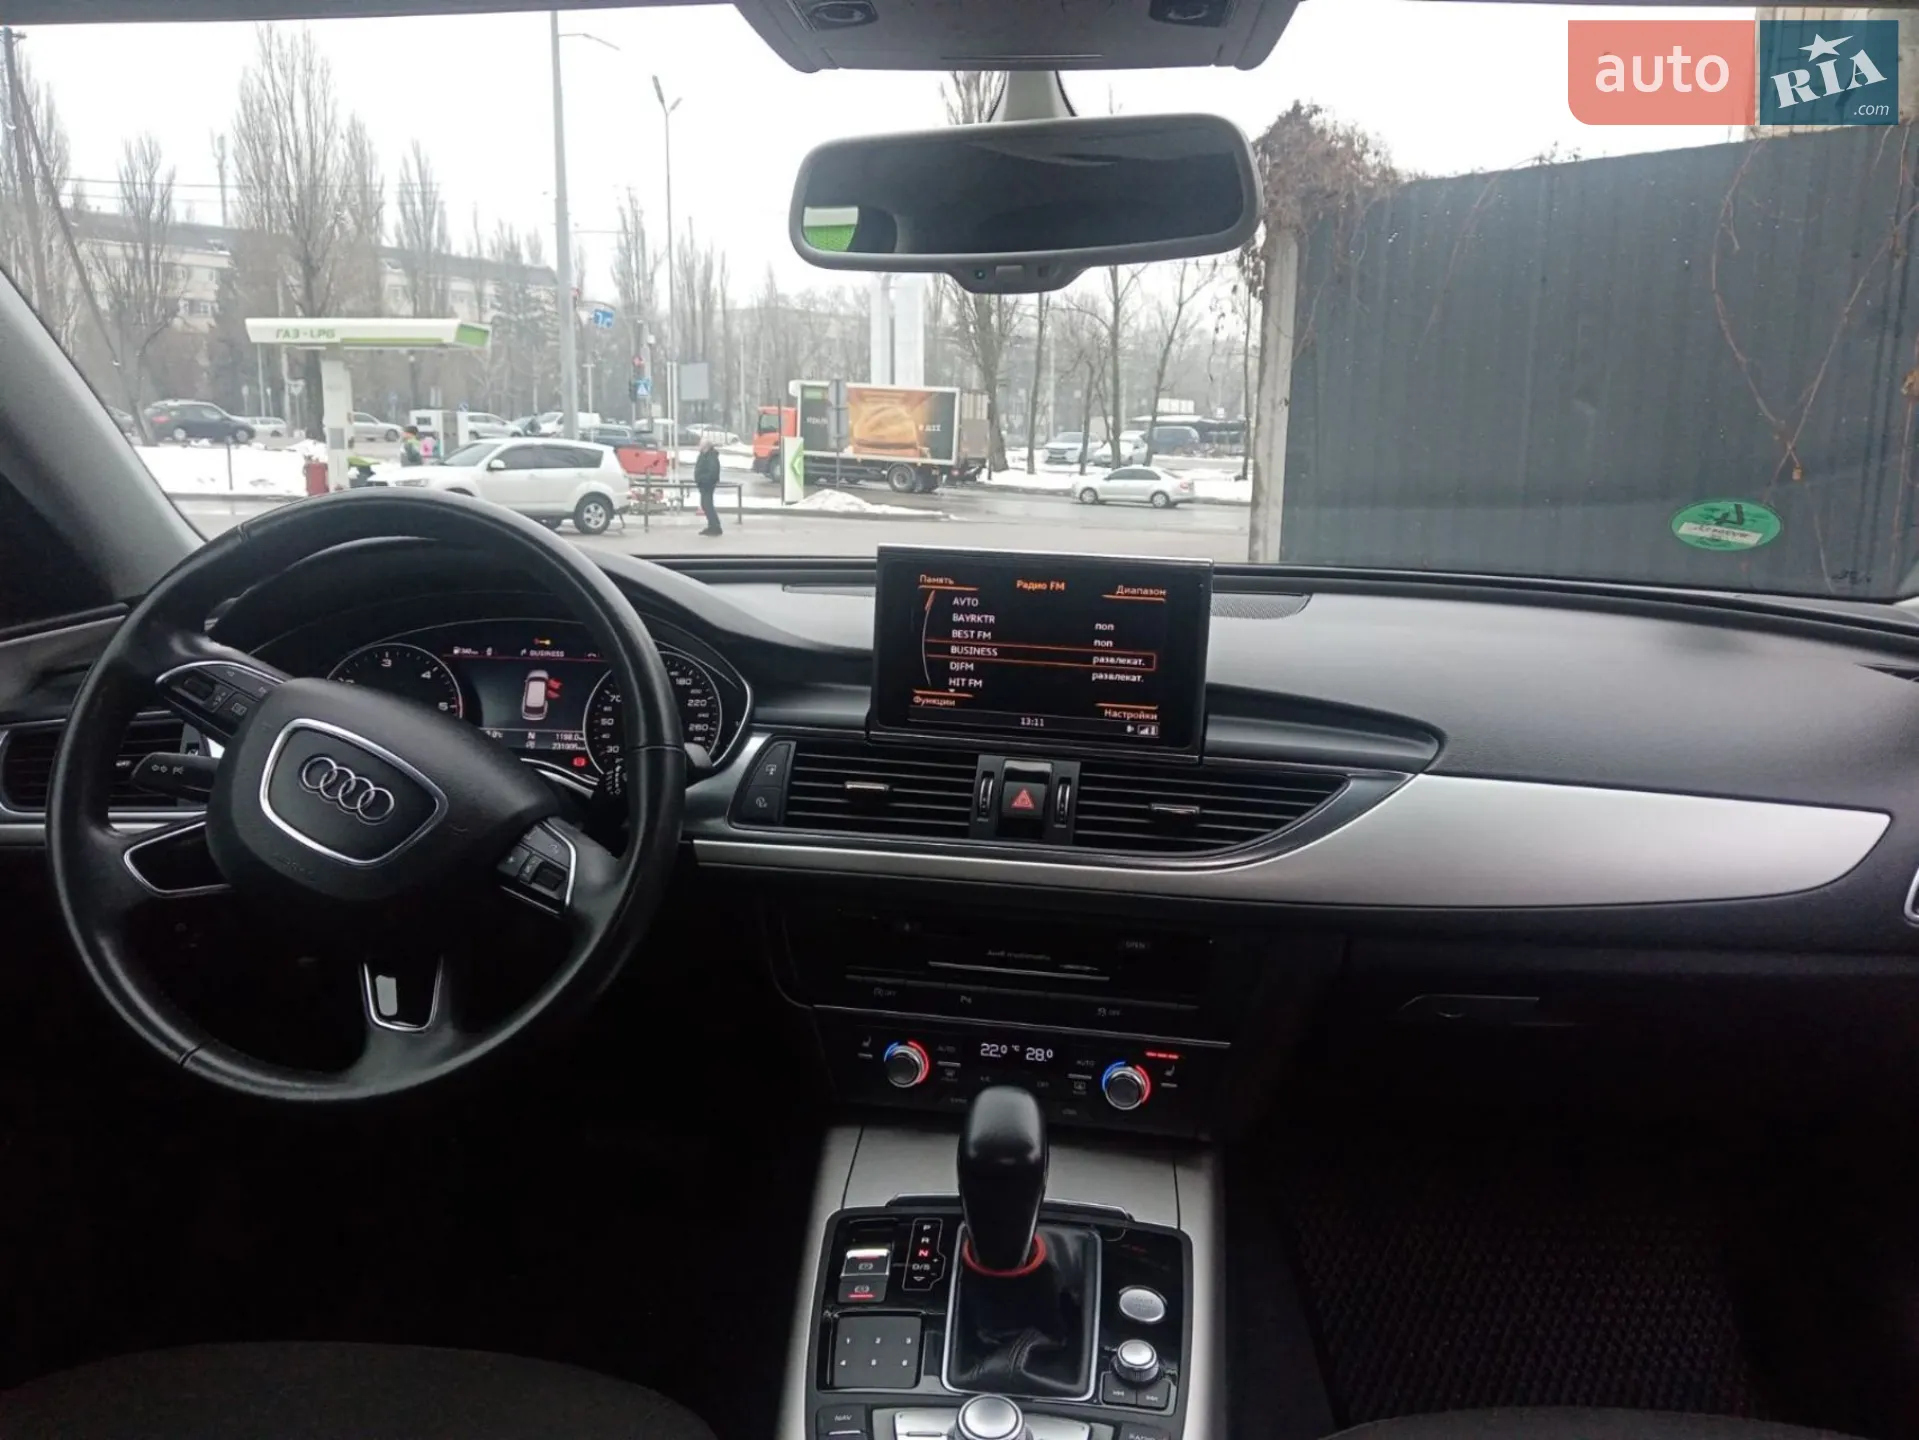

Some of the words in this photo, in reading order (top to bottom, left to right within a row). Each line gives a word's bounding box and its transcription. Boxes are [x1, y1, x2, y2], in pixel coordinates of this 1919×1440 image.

[919, 574, 955, 585] Память
[1016, 579, 1047, 591] Радио
[1049, 581, 1065, 591] FM
[1116, 585, 1167, 597] Диапазон
[952, 597, 979, 607] AVTO
[952, 613, 995, 624] BAYRKTR
[1095, 622, 1114, 632] поп
[951, 629, 975, 640] BEST
[976, 630, 992, 640] FM
[1093, 638, 1113, 648] поп
[950, 646, 998, 657] BUSINESS
[381, 658, 392, 668] 3
[1092, 654, 1146, 667] развлекат.
[949, 661, 974, 672] DJFM
[421, 671, 432, 680] 4
[1091, 671, 1145, 684] развлекат.
[675, 678, 694, 686] 180
[949, 677, 966, 688] HIT
[967, 678, 983, 689] FM
[687, 699, 708, 708] 220
[913, 695, 956, 708] Функции
[1104, 708, 1158, 721] Настройки
[600, 717, 614, 726] 50
[1020, 717, 1044, 728] 13:11
[688, 723, 710, 732] 260
[918, 1249, 930, 1257] N
